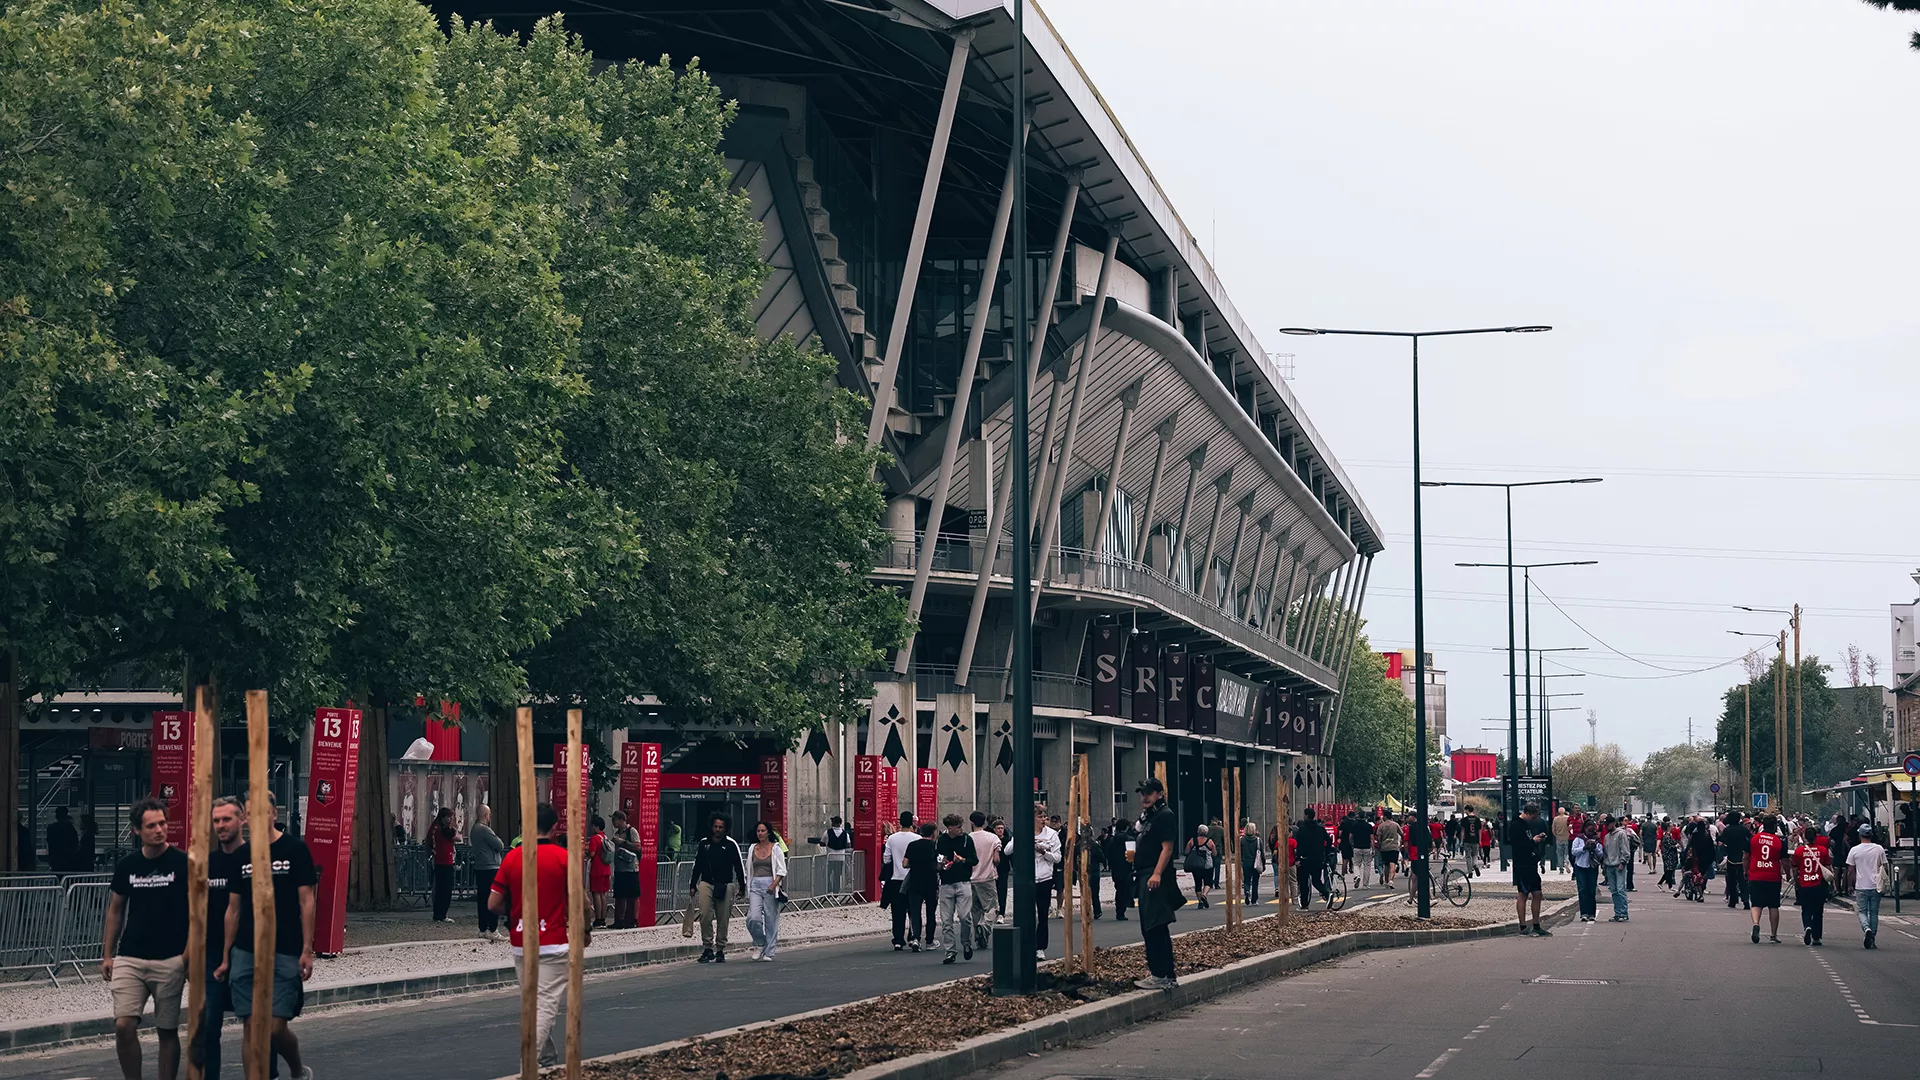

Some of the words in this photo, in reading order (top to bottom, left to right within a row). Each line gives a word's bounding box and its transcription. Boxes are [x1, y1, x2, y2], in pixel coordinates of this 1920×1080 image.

[1096, 654, 1117, 683] S
[1135, 666, 1156, 693] R
[1168, 677, 1185, 702] F
[1196, 686, 1212, 709] C
[322, 717, 342, 738] 13
[1278, 711, 1291, 729] 9
[1293, 715, 1306, 733] 0
[160, 720, 181, 741] 13
[352, 719, 360, 739] 13
[120, 731, 148, 749] PORTE
[317, 740, 343, 749] BIENVENUE
[625, 750, 638, 765] 12
[646, 750, 658, 766] 12
[764, 760, 779, 773] 12
[859, 760, 873, 773] 12
[702, 775, 737, 786] PORTE
[740, 775, 750, 786] 11
[923, 773, 932, 783] 11
[1470, 823, 1474, 833] 6
[1761, 845, 1770, 860] 9
[1804, 857, 1820, 873] 97
[1803, 873, 1820, 881] Blot
